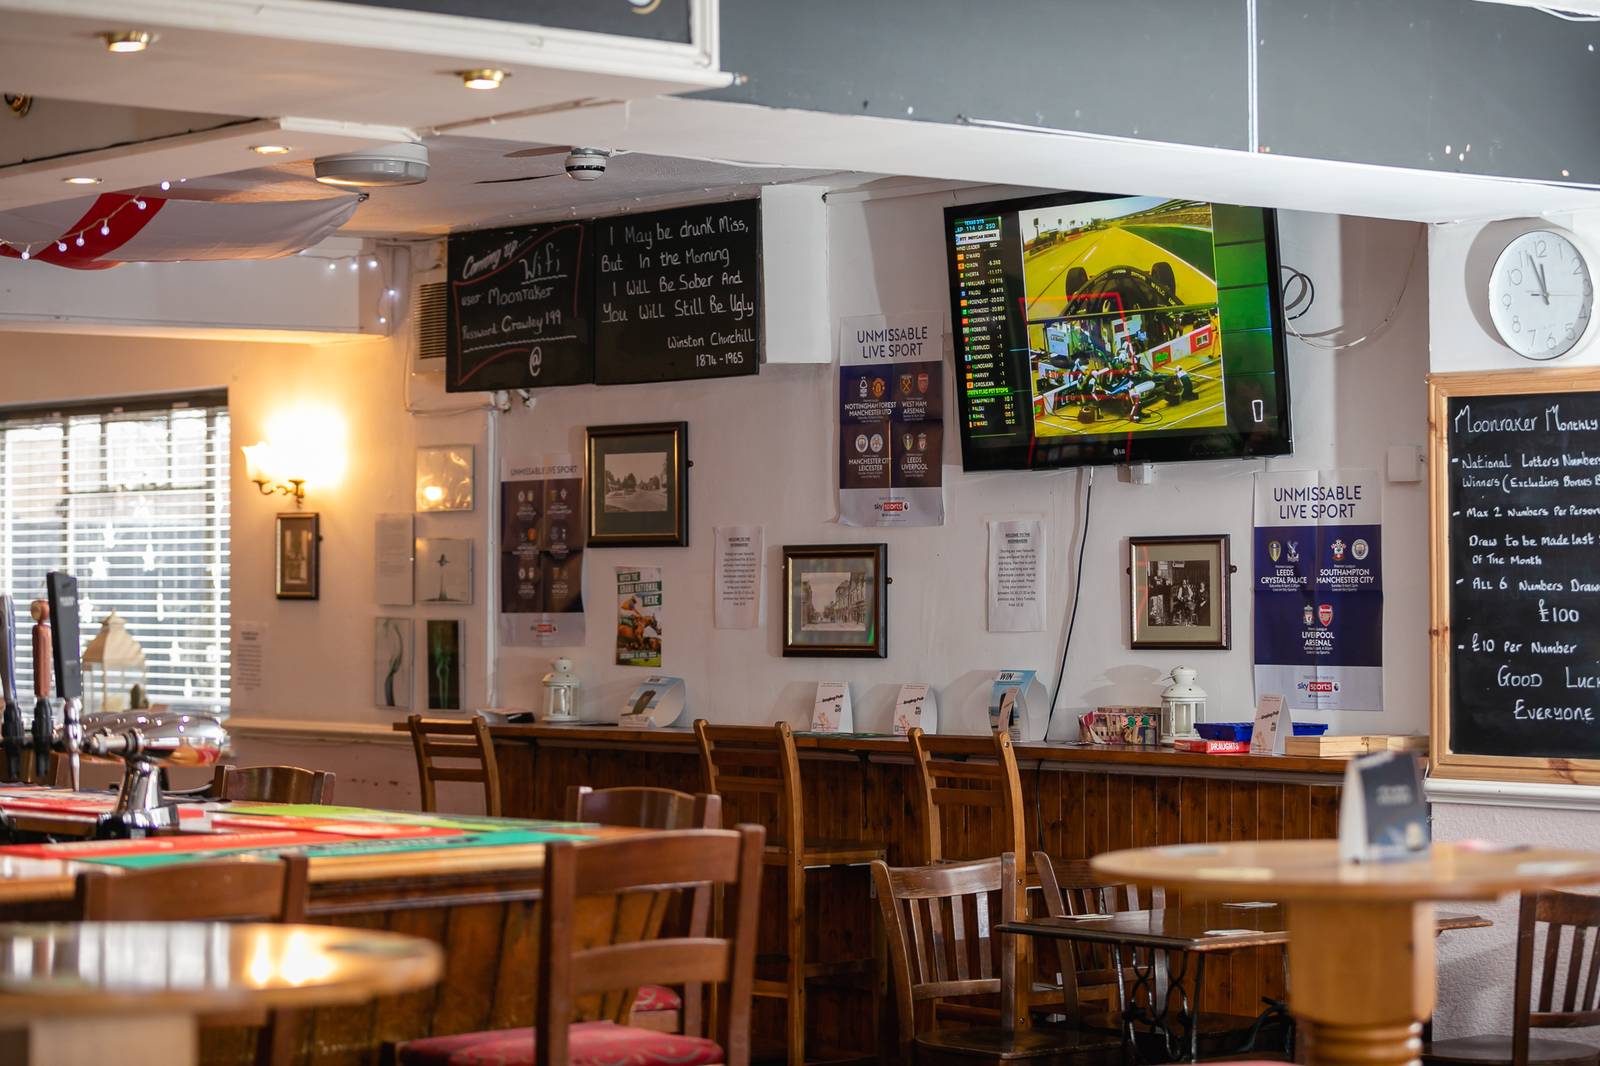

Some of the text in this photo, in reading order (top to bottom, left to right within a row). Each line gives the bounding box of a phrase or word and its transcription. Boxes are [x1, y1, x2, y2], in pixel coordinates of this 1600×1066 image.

[610, 226, 614, 246] I
[625, 226, 652, 249] May
[656, 222, 673, 241] be
[719, 215, 749, 233] Miss,
[1534, 240, 1547, 258] 12
[601, 248, 730, 273] But In the Morning
[612, 281, 617, 296] I
[659, 276, 677, 292] Be
[679, 274, 714, 291] Sober
[722, 269, 743, 285] And
[601, 302, 629, 323] You
[674, 297, 704, 317] Still
[709, 294, 726, 313] Be
[729, 293, 754, 321] Ugly
[501, 315, 543, 335] Crawley
[667, 328, 755, 349] Winston Churchill
[857, 326, 928, 344] UNMISSABLE
[862, 342, 923, 359] LIVE SPORT
[844, 402, 879, 410] NOTTINGHAM
[901, 400, 915, 408] WEST
[849, 409, 881, 417] MANCHESTER
[903, 407, 926, 415] ARSENAL
[1455, 404, 1598, 433] Moonraker Monthly
[848, 457, 882, 465] MANCHESTER
[906, 456, 922, 464] LEEDS
[1462, 453, 1512, 469] National
[1521, 453, 1559, 468] Lottery
[858, 464, 883, 472] LEICESTER
[901, 463, 929, 471] LIVERPOOL
[1462, 475, 1500, 488] Winners
[1563, 475, 1593, 488] Bonus
[1274, 485, 1362, 502] UNMISSABLE
[1279, 503, 1356, 520] LIVE SPORT
[1466, 506, 1489, 517] Max
[1493, 506, 1503, 517] 2
[1507, 505, 1549, 517] Numbers
[1553, 505, 1567, 516] Per
[1469, 534, 1498, 547] Draw
[1505, 534, 1519, 546] to
[1522, 535, 1538, 547] be
[1472, 553, 1542, 566] Of The Month
[1276, 569, 1294, 577] LEEDS
[1319, 568, 1370, 576] SOUTHAMPTON
[1260, 576, 1308, 584] CRYSTAL PALACE
[1316, 576, 1375, 584] MANCHESTER CITY
[1499, 577, 1509, 590] 6
[1518, 579, 1564, 592] Numbers
[1538, 598, 1580, 623] £100
[1304, 639, 1332, 647] ARSENAL
[1472, 632, 1578, 655] £10 Per Number
[1000, 672, 1015, 681] WIN
[1297, 681, 1309, 691] sky
[1210, 742, 1240, 751] DRAUGHTS
